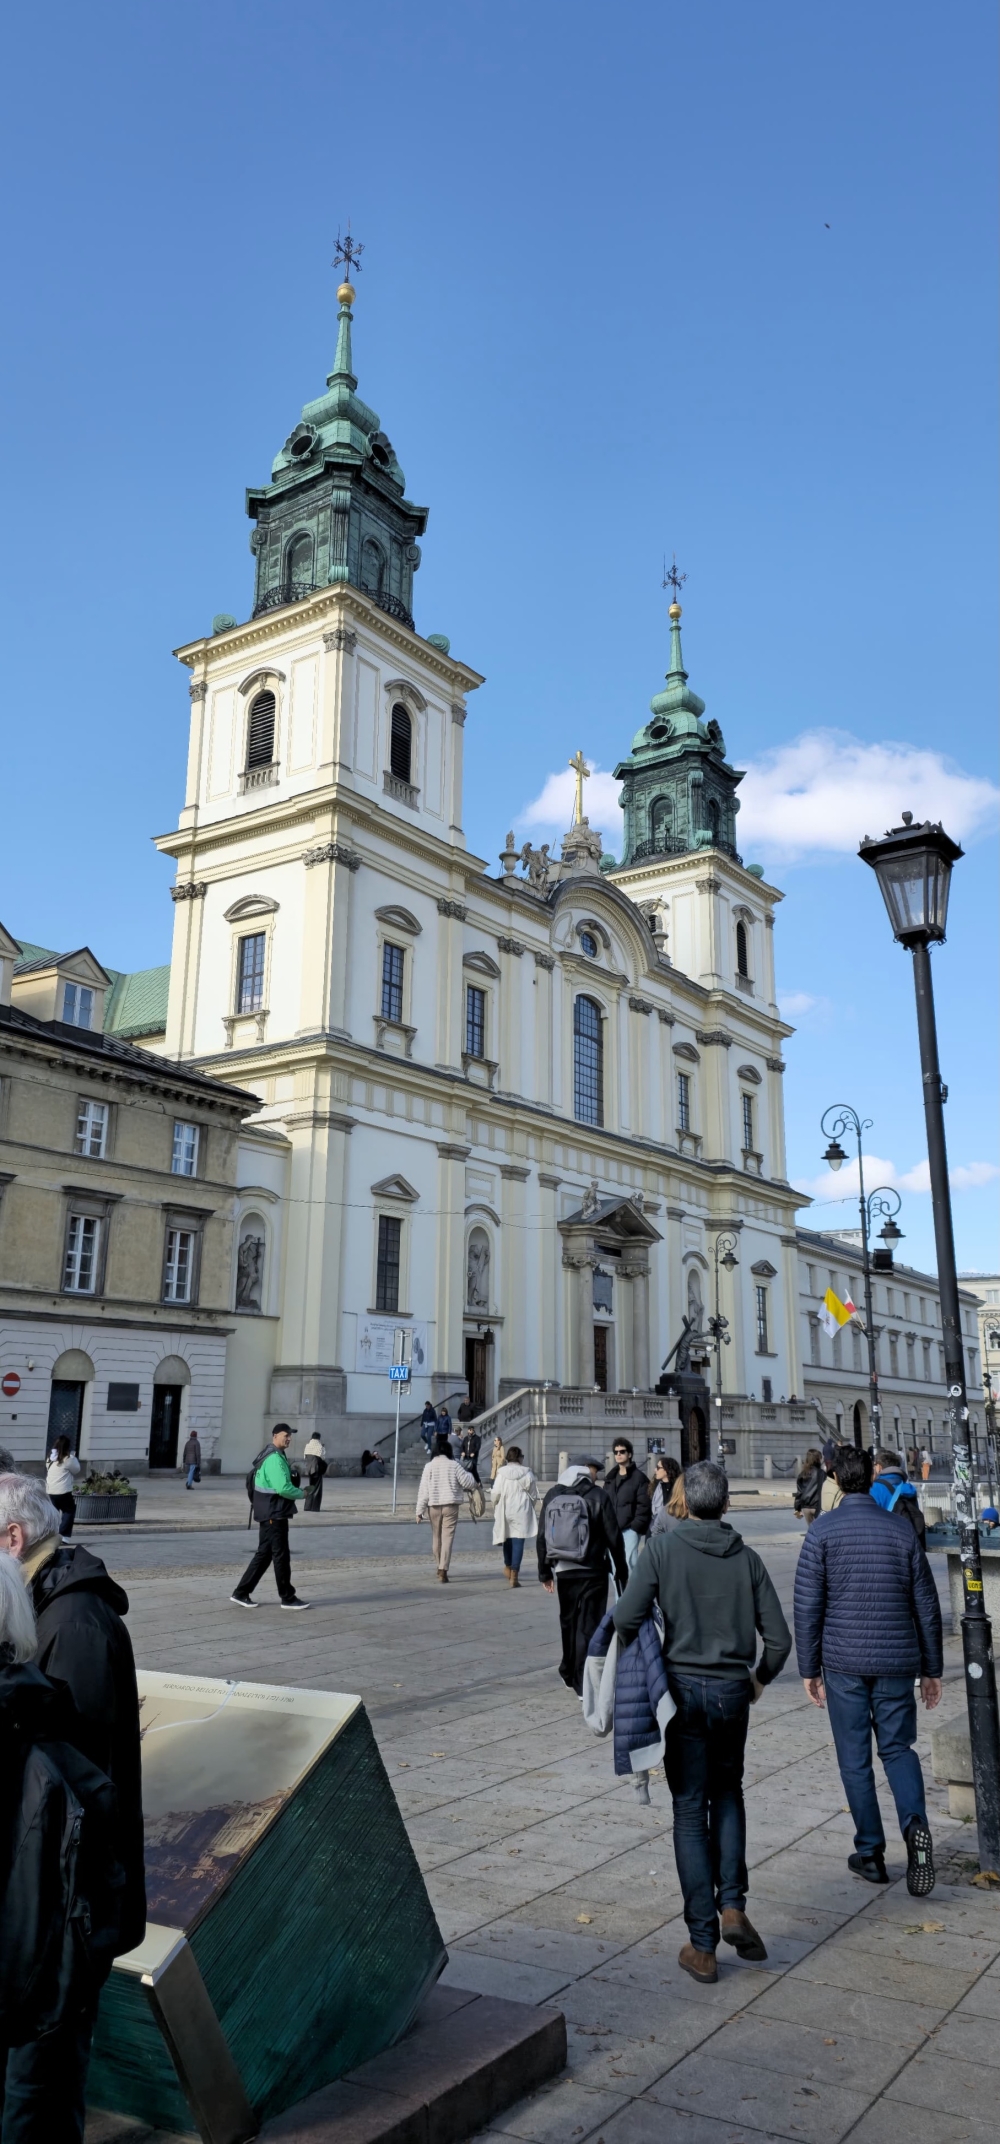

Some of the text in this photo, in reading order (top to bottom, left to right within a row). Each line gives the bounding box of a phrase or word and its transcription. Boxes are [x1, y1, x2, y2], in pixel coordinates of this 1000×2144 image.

[390, 1368, 407, 1379] TAXI
[162, 1683, 195, 1692] BERNARDO
[195, 1686, 225, 1695] BELLOTTO
